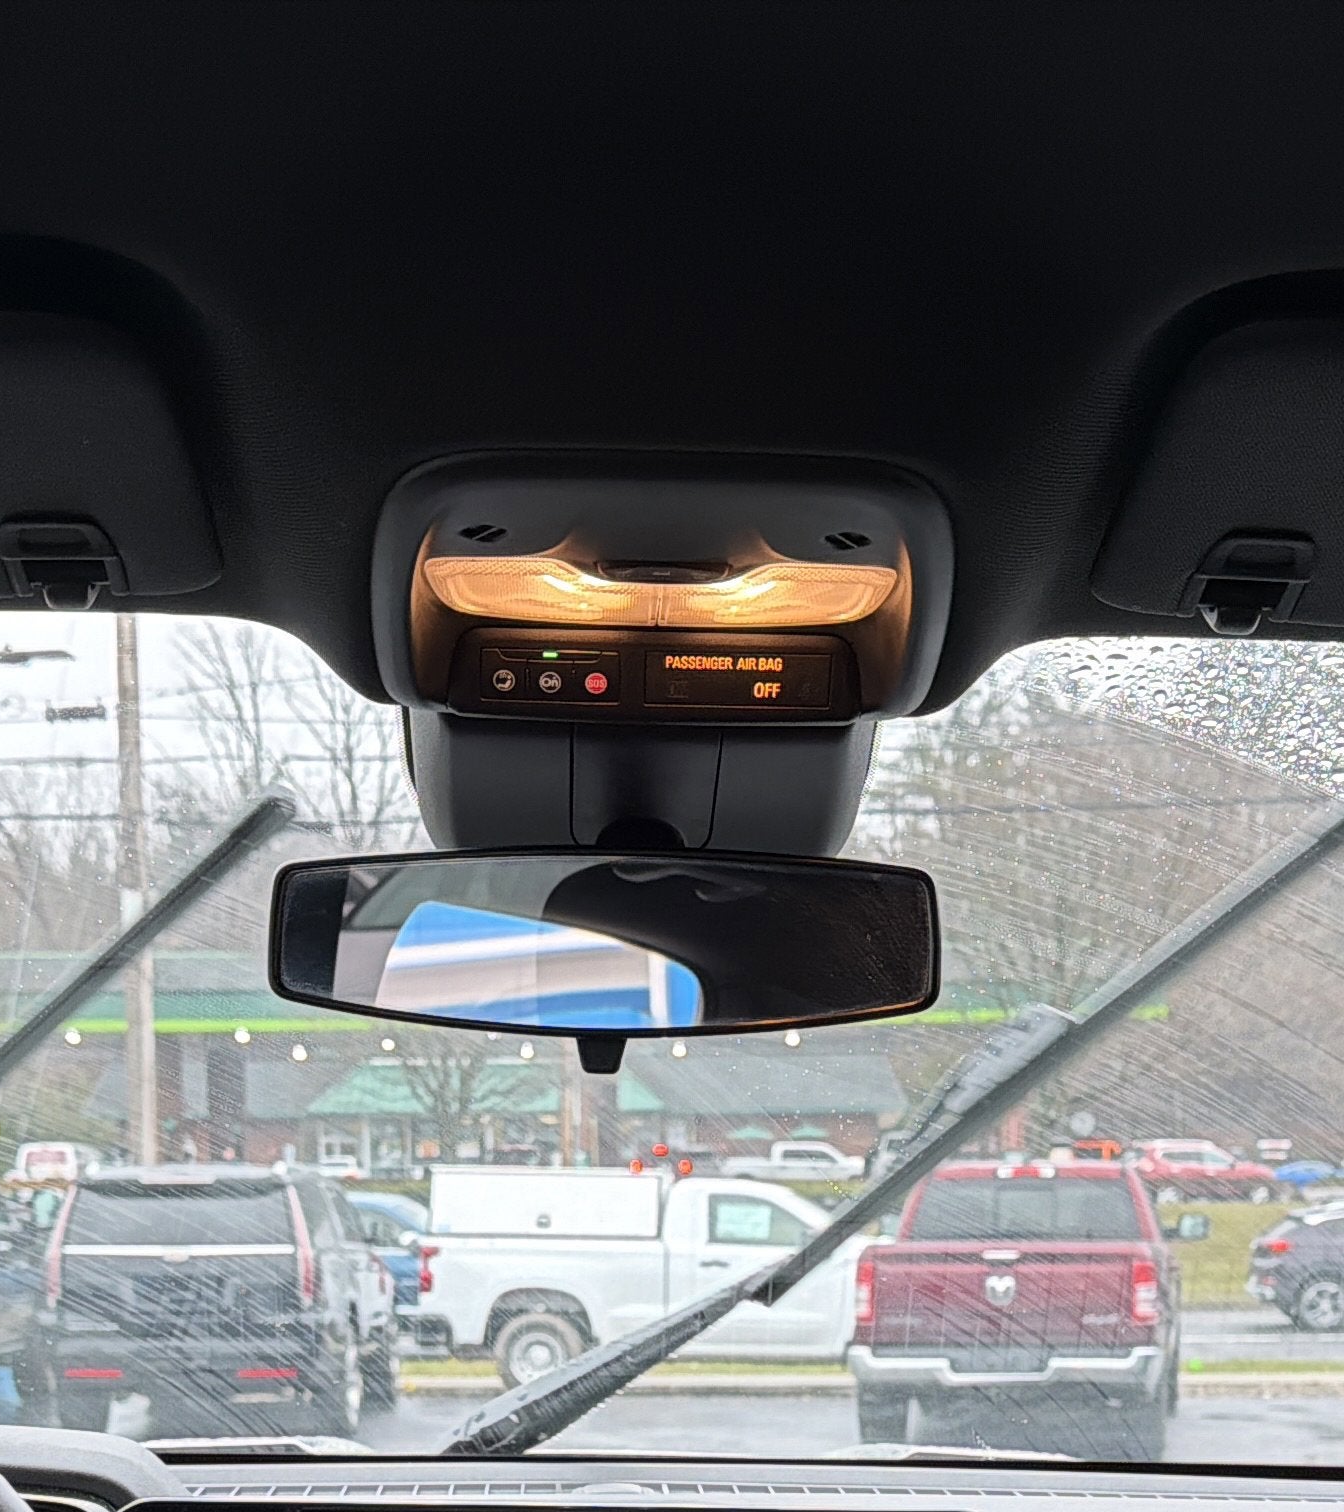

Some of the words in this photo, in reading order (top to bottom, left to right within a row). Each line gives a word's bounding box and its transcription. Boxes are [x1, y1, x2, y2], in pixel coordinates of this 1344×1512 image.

[665, 655, 734, 671] PASSENGER
[736, 656, 757, 671] AIR
[758, 657, 783, 673] BAG
[587, 678, 605, 689] SOS
[753, 682, 782, 698] OFF
